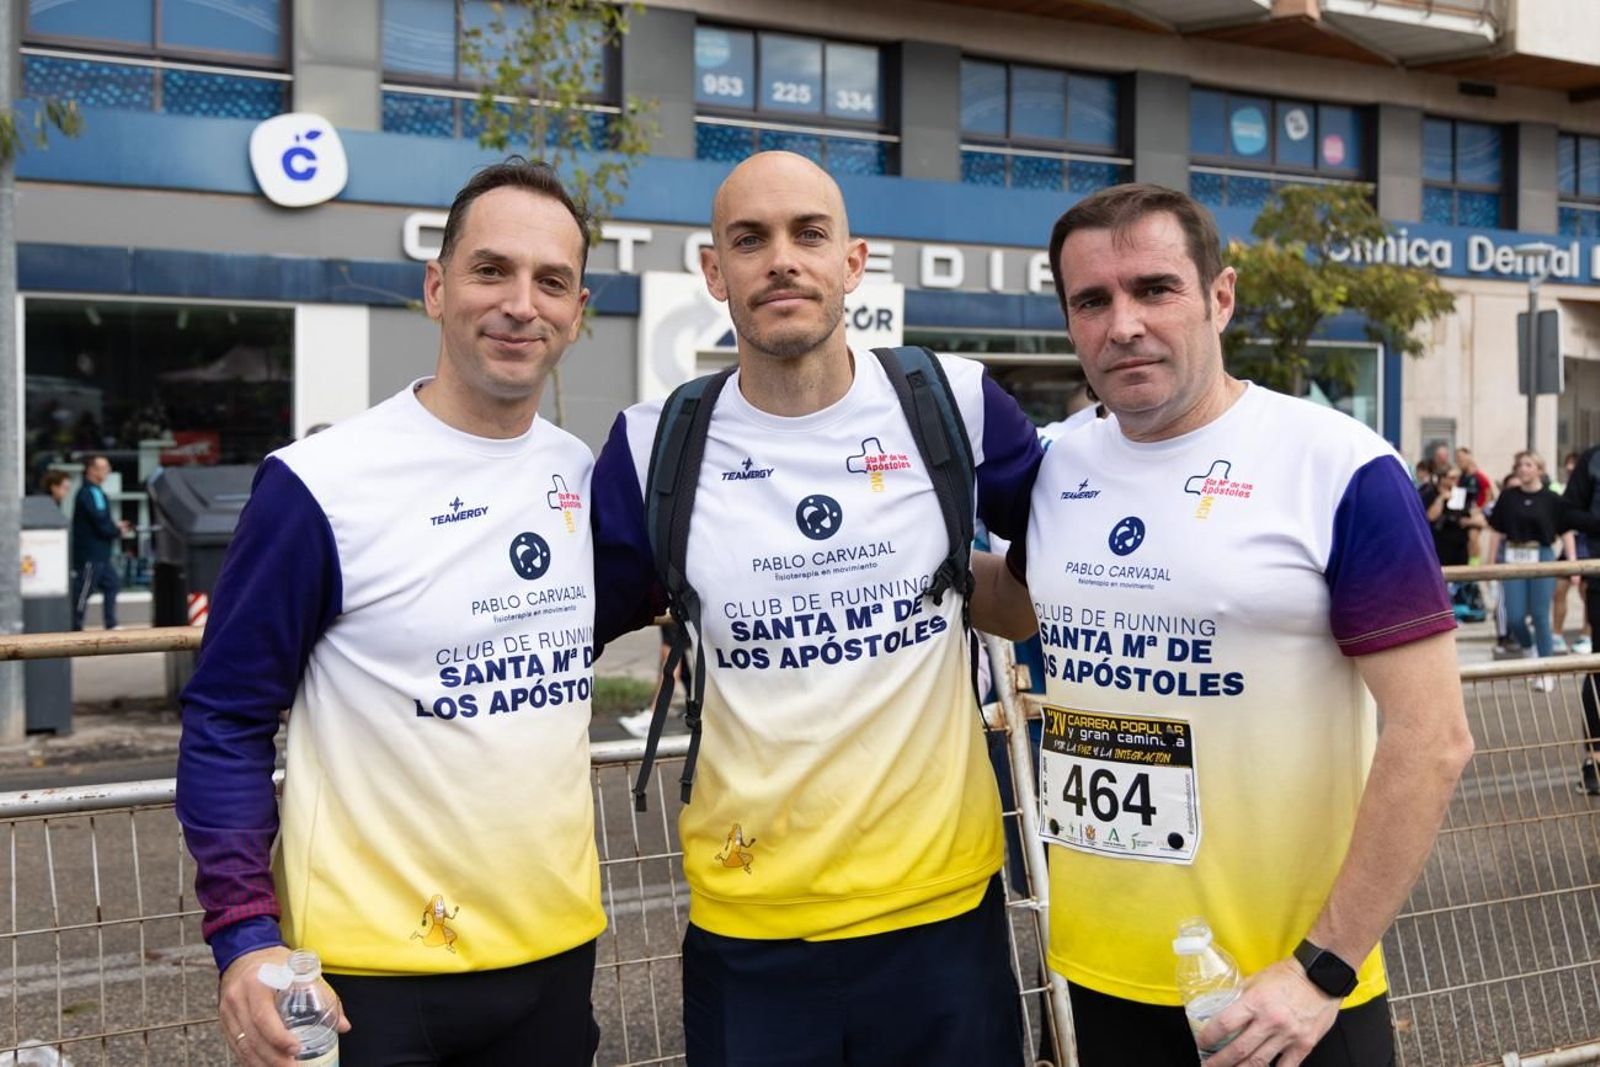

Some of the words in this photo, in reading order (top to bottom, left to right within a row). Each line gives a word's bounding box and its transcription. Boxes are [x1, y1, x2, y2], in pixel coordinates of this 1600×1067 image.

[703, 73, 744, 98] 953
[772, 81, 811, 104] 225
[836, 89, 875, 112] 334
[721, 467, 775, 482] TEAMERGY
[430, 506, 489, 526] TEAMERGY
[752, 554, 806, 573] PABLO
[811, 541, 897, 566] CARVAJAL
[1065, 561, 1105, 577] PABLO
[1108, 565, 1172, 582] CARVAJAL
[471, 594, 521, 616] PABLO
[526, 585, 587, 606] CARVAJAL
[724, 598, 782, 619] CLUB
[793, 593, 822, 613] DE
[831, 574, 930, 609] RUNNING
[731, 611, 838, 643] SANTA
[845, 602, 884, 632] Mª
[893, 593, 925, 622] DE
[1034, 602, 1073, 624] CLUB
[1081, 608, 1106, 628] DE
[1114, 611, 1217, 637] RUNNING
[435, 640, 495, 666] CLUB
[503, 634, 532, 653] DE
[716, 647, 771, 670] LOS
[779, 614, 948, 670] APÓSTOLES
[1040, 621, 1113, 656] SANTA
[1122, 633, 1159, 660] Mª
[1167, 637, 1213, 664] DE
[439, 653, 546, 689] SANTA
[553, 647, 578, 674] Mª
[1062, 656, 1245, 698] APÓSTOLES
[412, 694, 479, 721] LOS
[1067, 714, 1118, 731] CARRERA
[1080, 728, 1111, 742] gran
[1116, 733, 1186, 748] camina
[1062, 763, 1158, 827] 464
